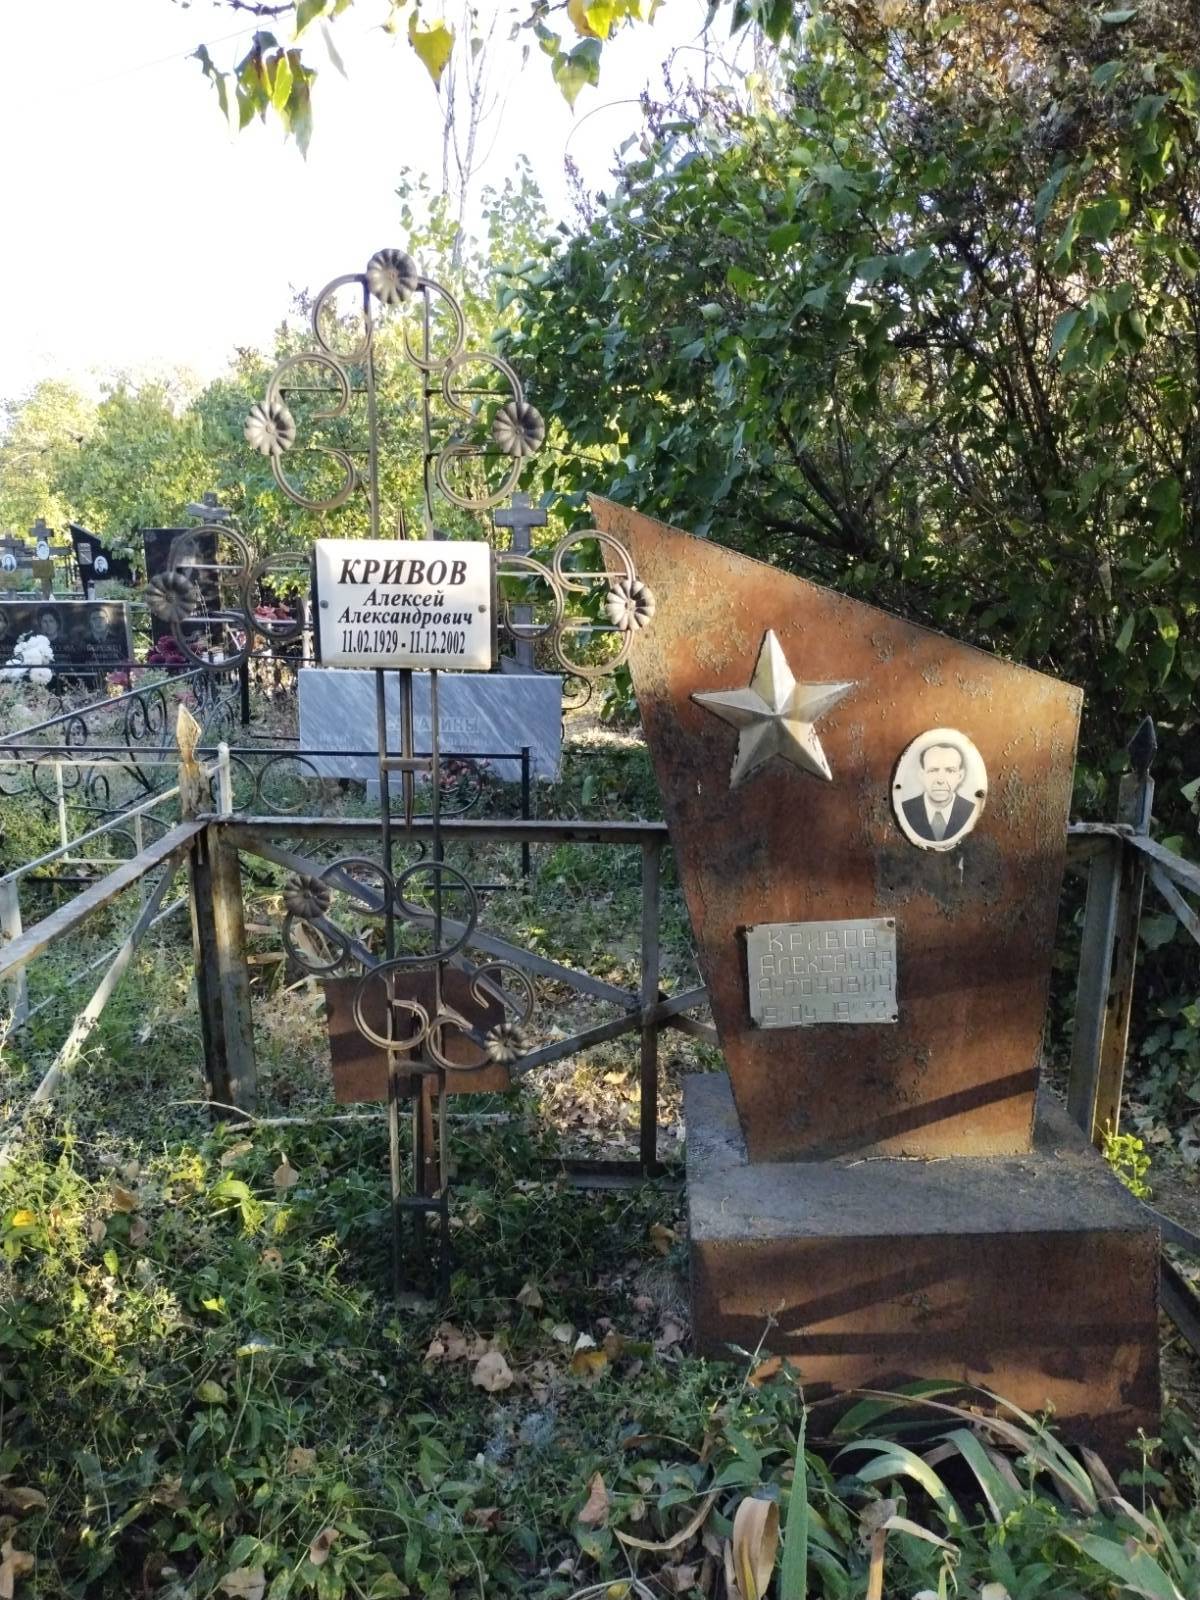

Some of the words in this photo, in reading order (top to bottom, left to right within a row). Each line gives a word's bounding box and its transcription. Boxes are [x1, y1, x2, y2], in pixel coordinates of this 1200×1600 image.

[337, 558, 468, 585] КРИВОВ
[363, 588, 445, 607] Алексей
[338, 606, 473, 629] Александрович
[341, 629, 399, 653] 11.02.1929
[409, 630, 466, 654] 11.12.2002
[768, 928, 877, 951] КРИВОВ
